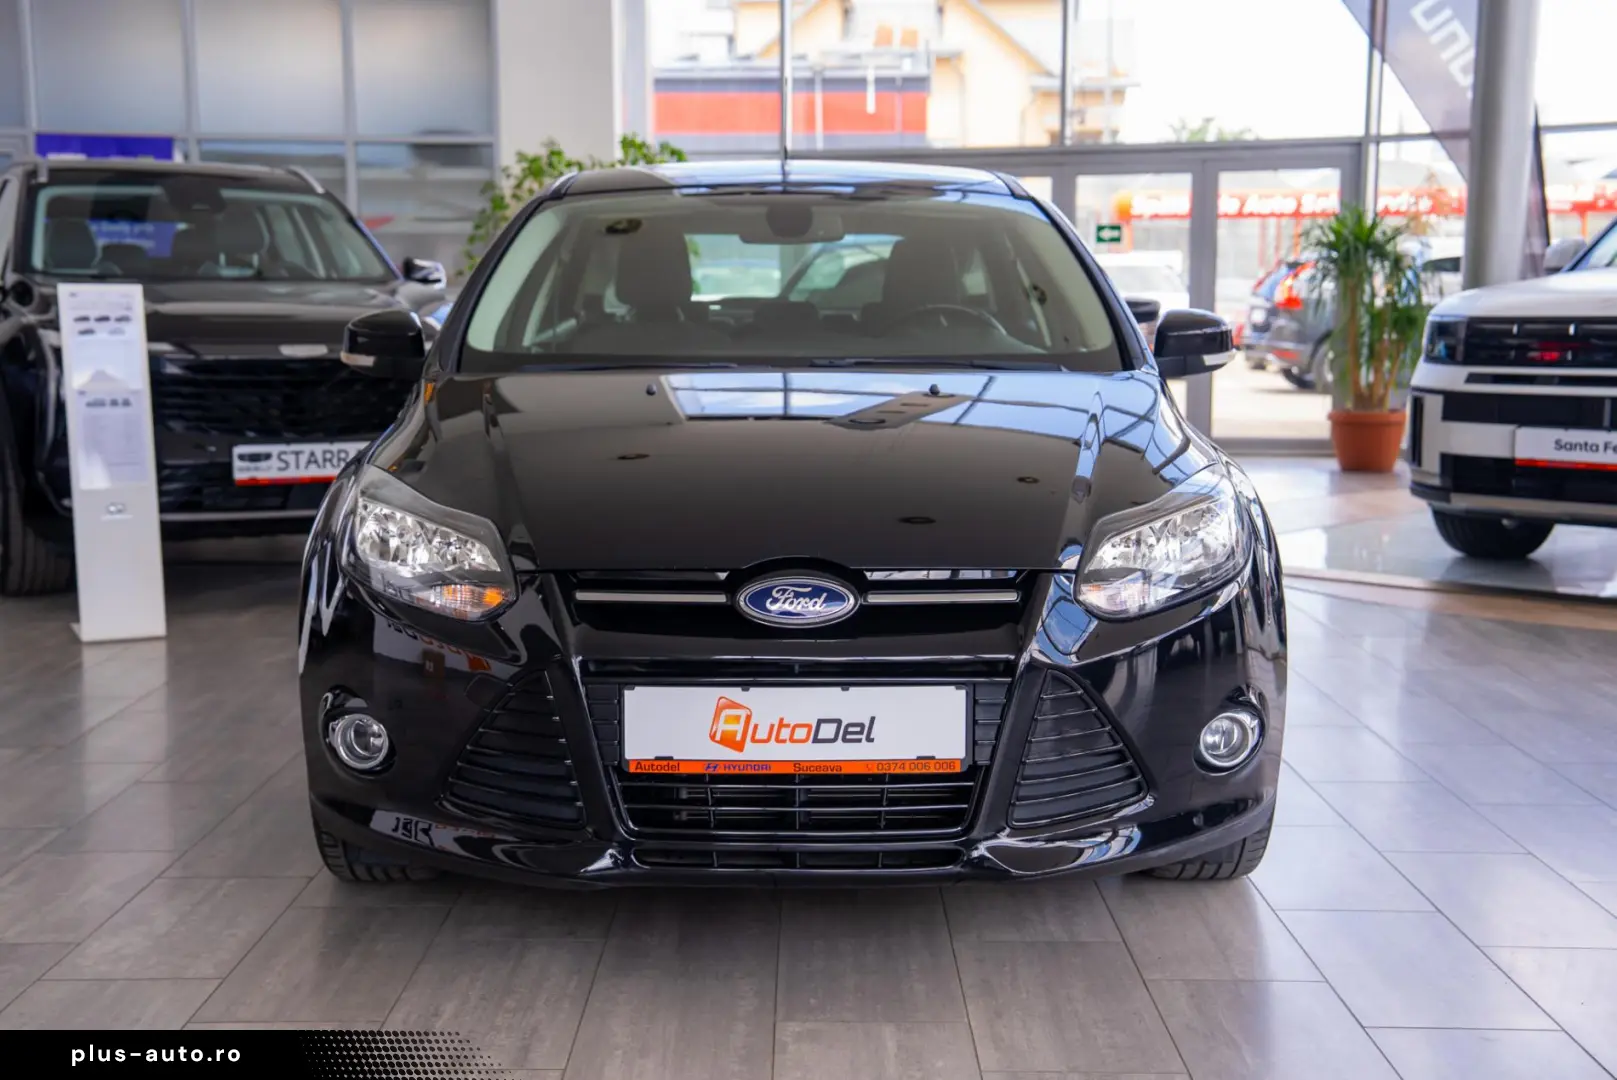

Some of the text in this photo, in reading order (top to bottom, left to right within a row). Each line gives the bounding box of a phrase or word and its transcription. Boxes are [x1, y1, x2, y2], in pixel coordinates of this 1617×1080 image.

[1554, 438, 1600, 454] Santa
[277, 448, 361, 472] STARR
[765, 585, 828, 611] Ford
[711, 707, 877, 744] AutoDel
[634, 761, 681, 773] Autodel
[793, 762, 843, 773] Suceava
[876, 761, 956, 772] 0374 006 006
